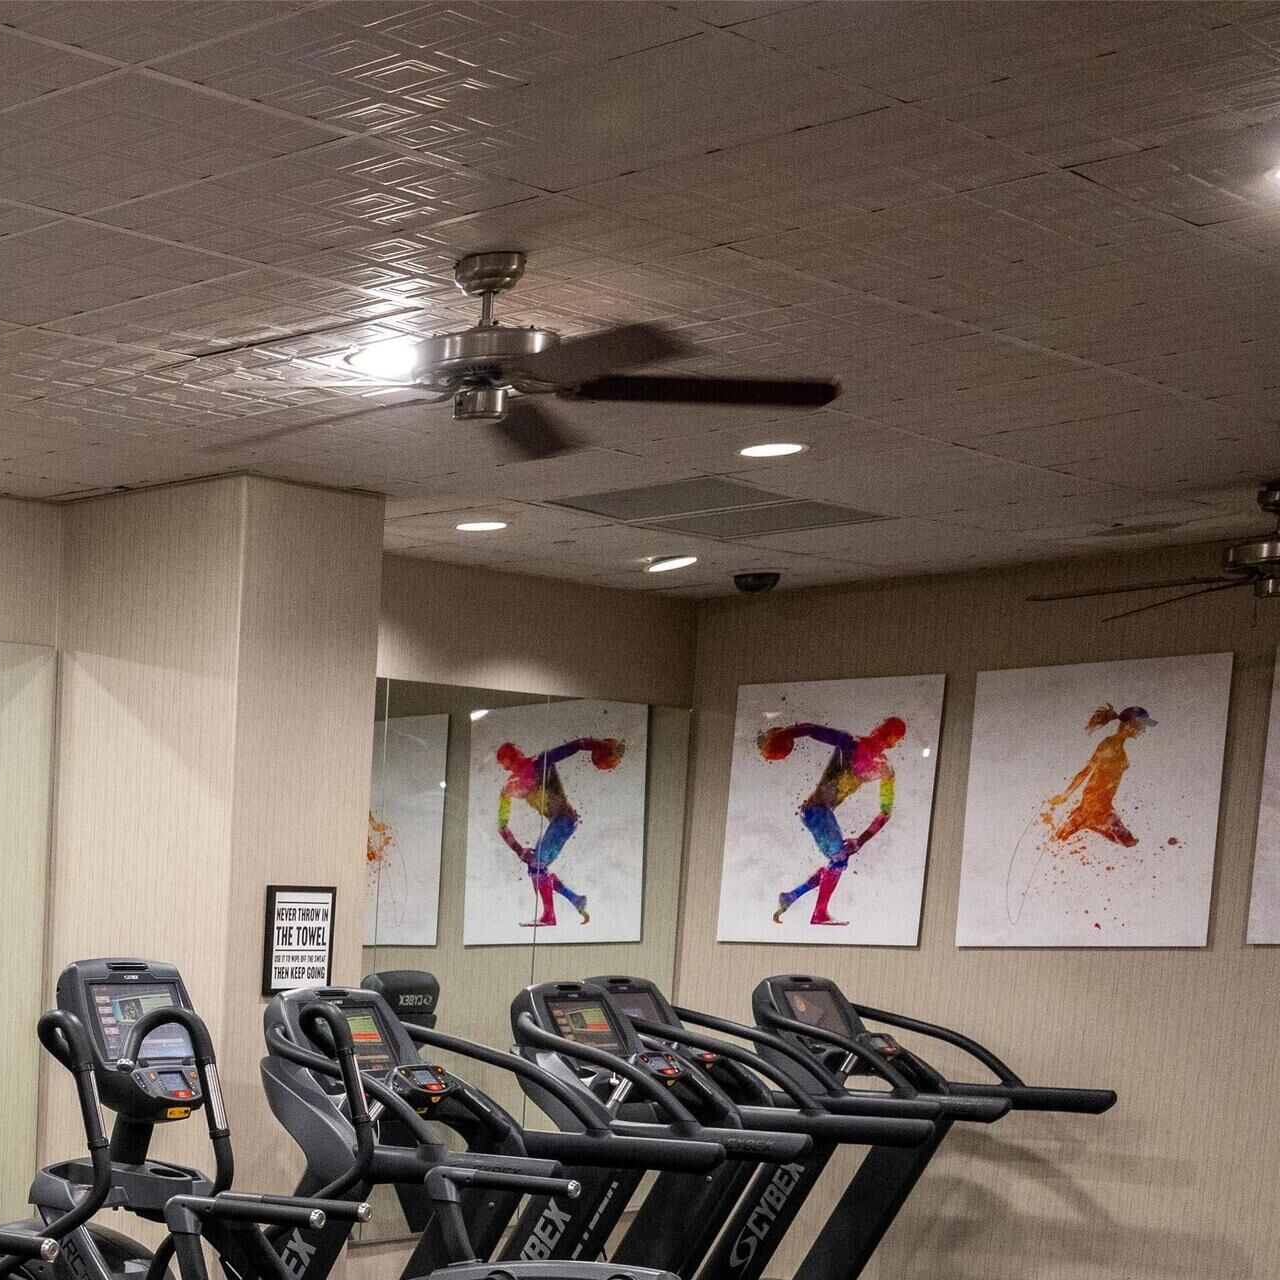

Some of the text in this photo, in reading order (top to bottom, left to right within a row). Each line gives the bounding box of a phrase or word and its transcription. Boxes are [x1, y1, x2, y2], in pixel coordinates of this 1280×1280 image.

[276, 908, 329, 922] NEVER THROW IN
[276, 926, 326, 946] THE TOWEL
[291, 955, 300, 963] WIPE
[314, 955, 326, 963] SWEAT
[274, 966, 325, 979] THEN KEEP GOING
[746, 1162, 806, 1241] CYBEX
